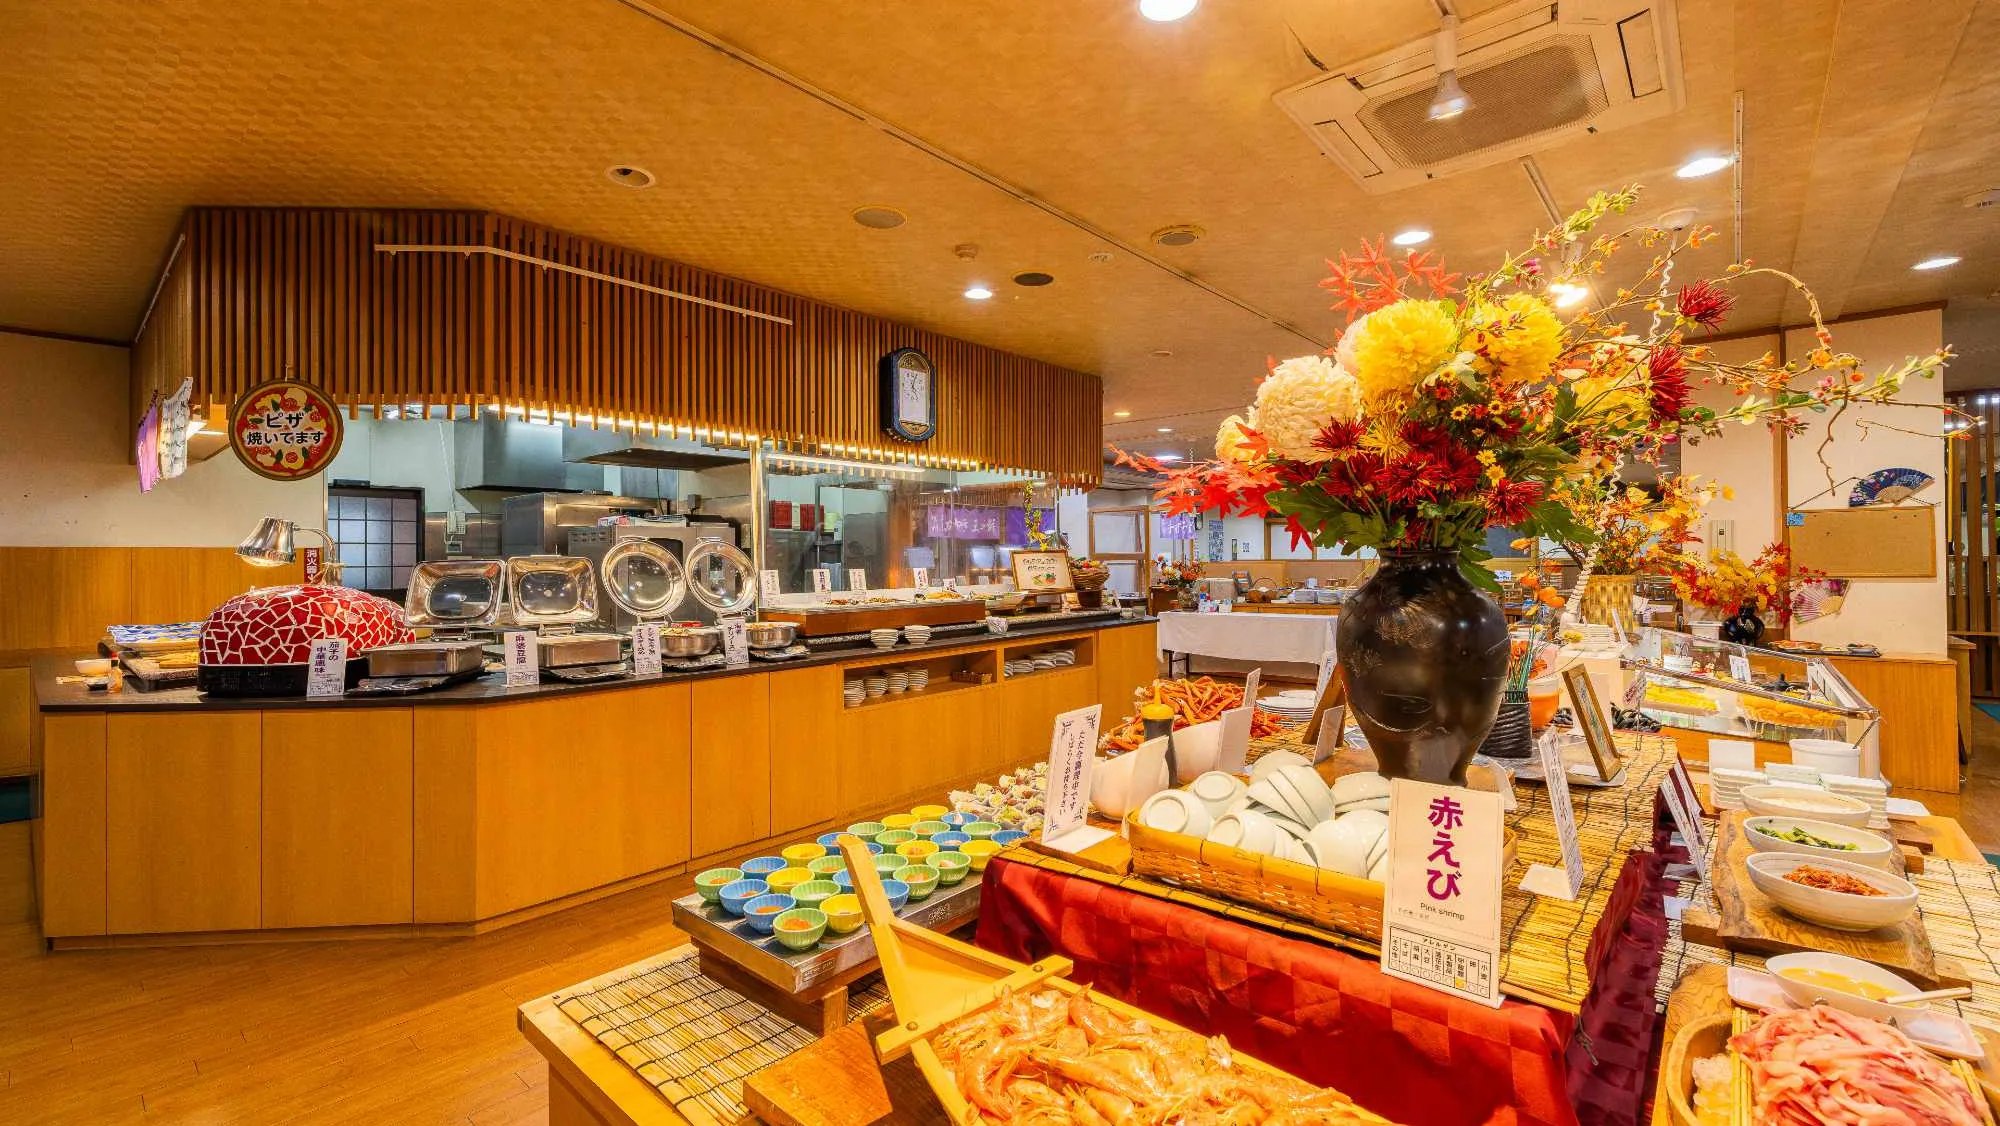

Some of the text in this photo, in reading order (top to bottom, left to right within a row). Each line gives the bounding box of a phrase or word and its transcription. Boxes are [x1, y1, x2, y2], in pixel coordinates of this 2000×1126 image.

[266, 412, 305, 428] ピザ
[247, 431, 324, 445] 焼いてます
[328, 641, 340, 661] 茄子の
[515, 635, 527, 665] 麻婆豆腐
[314, 646, 327, 674] 中華風味
[1427, 796, 1463, 901] 赤えび
[1420, 902, 1437, 914] Pink
[1438, 907, 1465, 920] shrimp
[1423, 938, 1457, 951] アレルゲン
